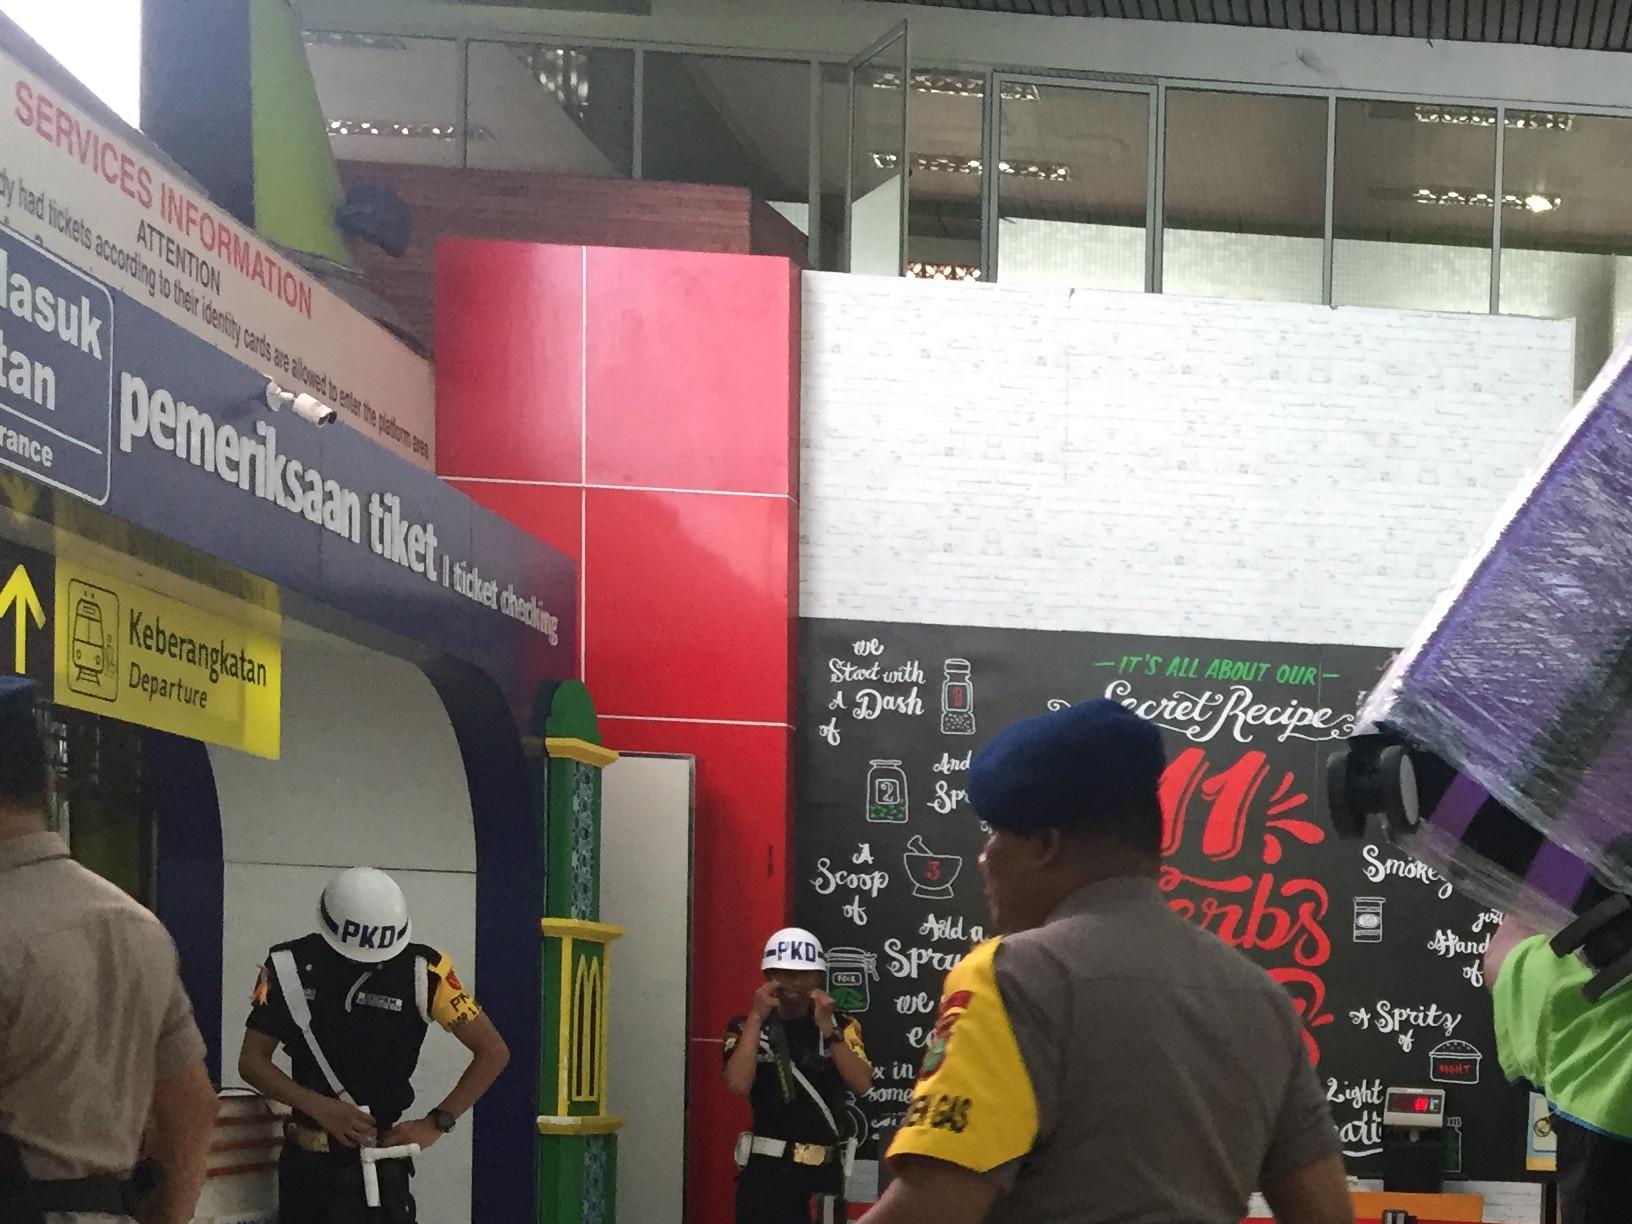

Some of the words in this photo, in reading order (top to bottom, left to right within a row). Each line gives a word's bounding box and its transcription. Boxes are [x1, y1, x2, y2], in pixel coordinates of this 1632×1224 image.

[15, 80, 153, 210] SERVICES
[161, 182, 313, 319] INFORMATION
[137, 219, 221, 296] ATTENTION
[19, 177, 45, 220] had
[48, 198, 92, 250] tickets
[95, 234, 156, 297] according
[159, 270, 171, 299] to
[173, 279, 199, 318] their
[202, 296, 241, 348] identity
[243, 327, 272, 361] cards
[274, 347, 290, 373] are
[291, 356, 327, 395] allowed
[328, 380, 338, 402] to
[339, 390, 362, 417] enter
[363, 402, 377, 427] the
[378, 413, 412, 448] platform
[412, 436, 430, 459] area
[120, 370, 361, 544] pemeriksaan
[368, 489, 438, 582] tiket
[453, 560, 498, 610] ticket
[500, 584, 559, 646] checking
[129, 608, 267, 688] Keberangkatan
[128, 663, 208, 710] Departure
[882, 660, 927, 684] with
[1118, 655, 1157, 675] IT'S
[1166, 658, 1198, 678] ALL
[1206, 659, 1271, 682] ABOUT
[1276, 664, 1319, 687] OUR
[852, 686, 925, 720] Dash
[1104, 680, 1222, 724] Secret
[1192, 684, 1354, 743] Recipe
[819, 717, 841, 746] of
[852, 842, 875, 865] A
[809, 858, 889, 898] Scoop
[842, 896, 869, 926] of
[919, 913, 967, 942] Add
[340, 918, 397, 950] PKD
[777, 940, 817, 963] PKD
[1463, 959, 1485, 988] of
[1375, 1000, 1462, 1037] Spritz
